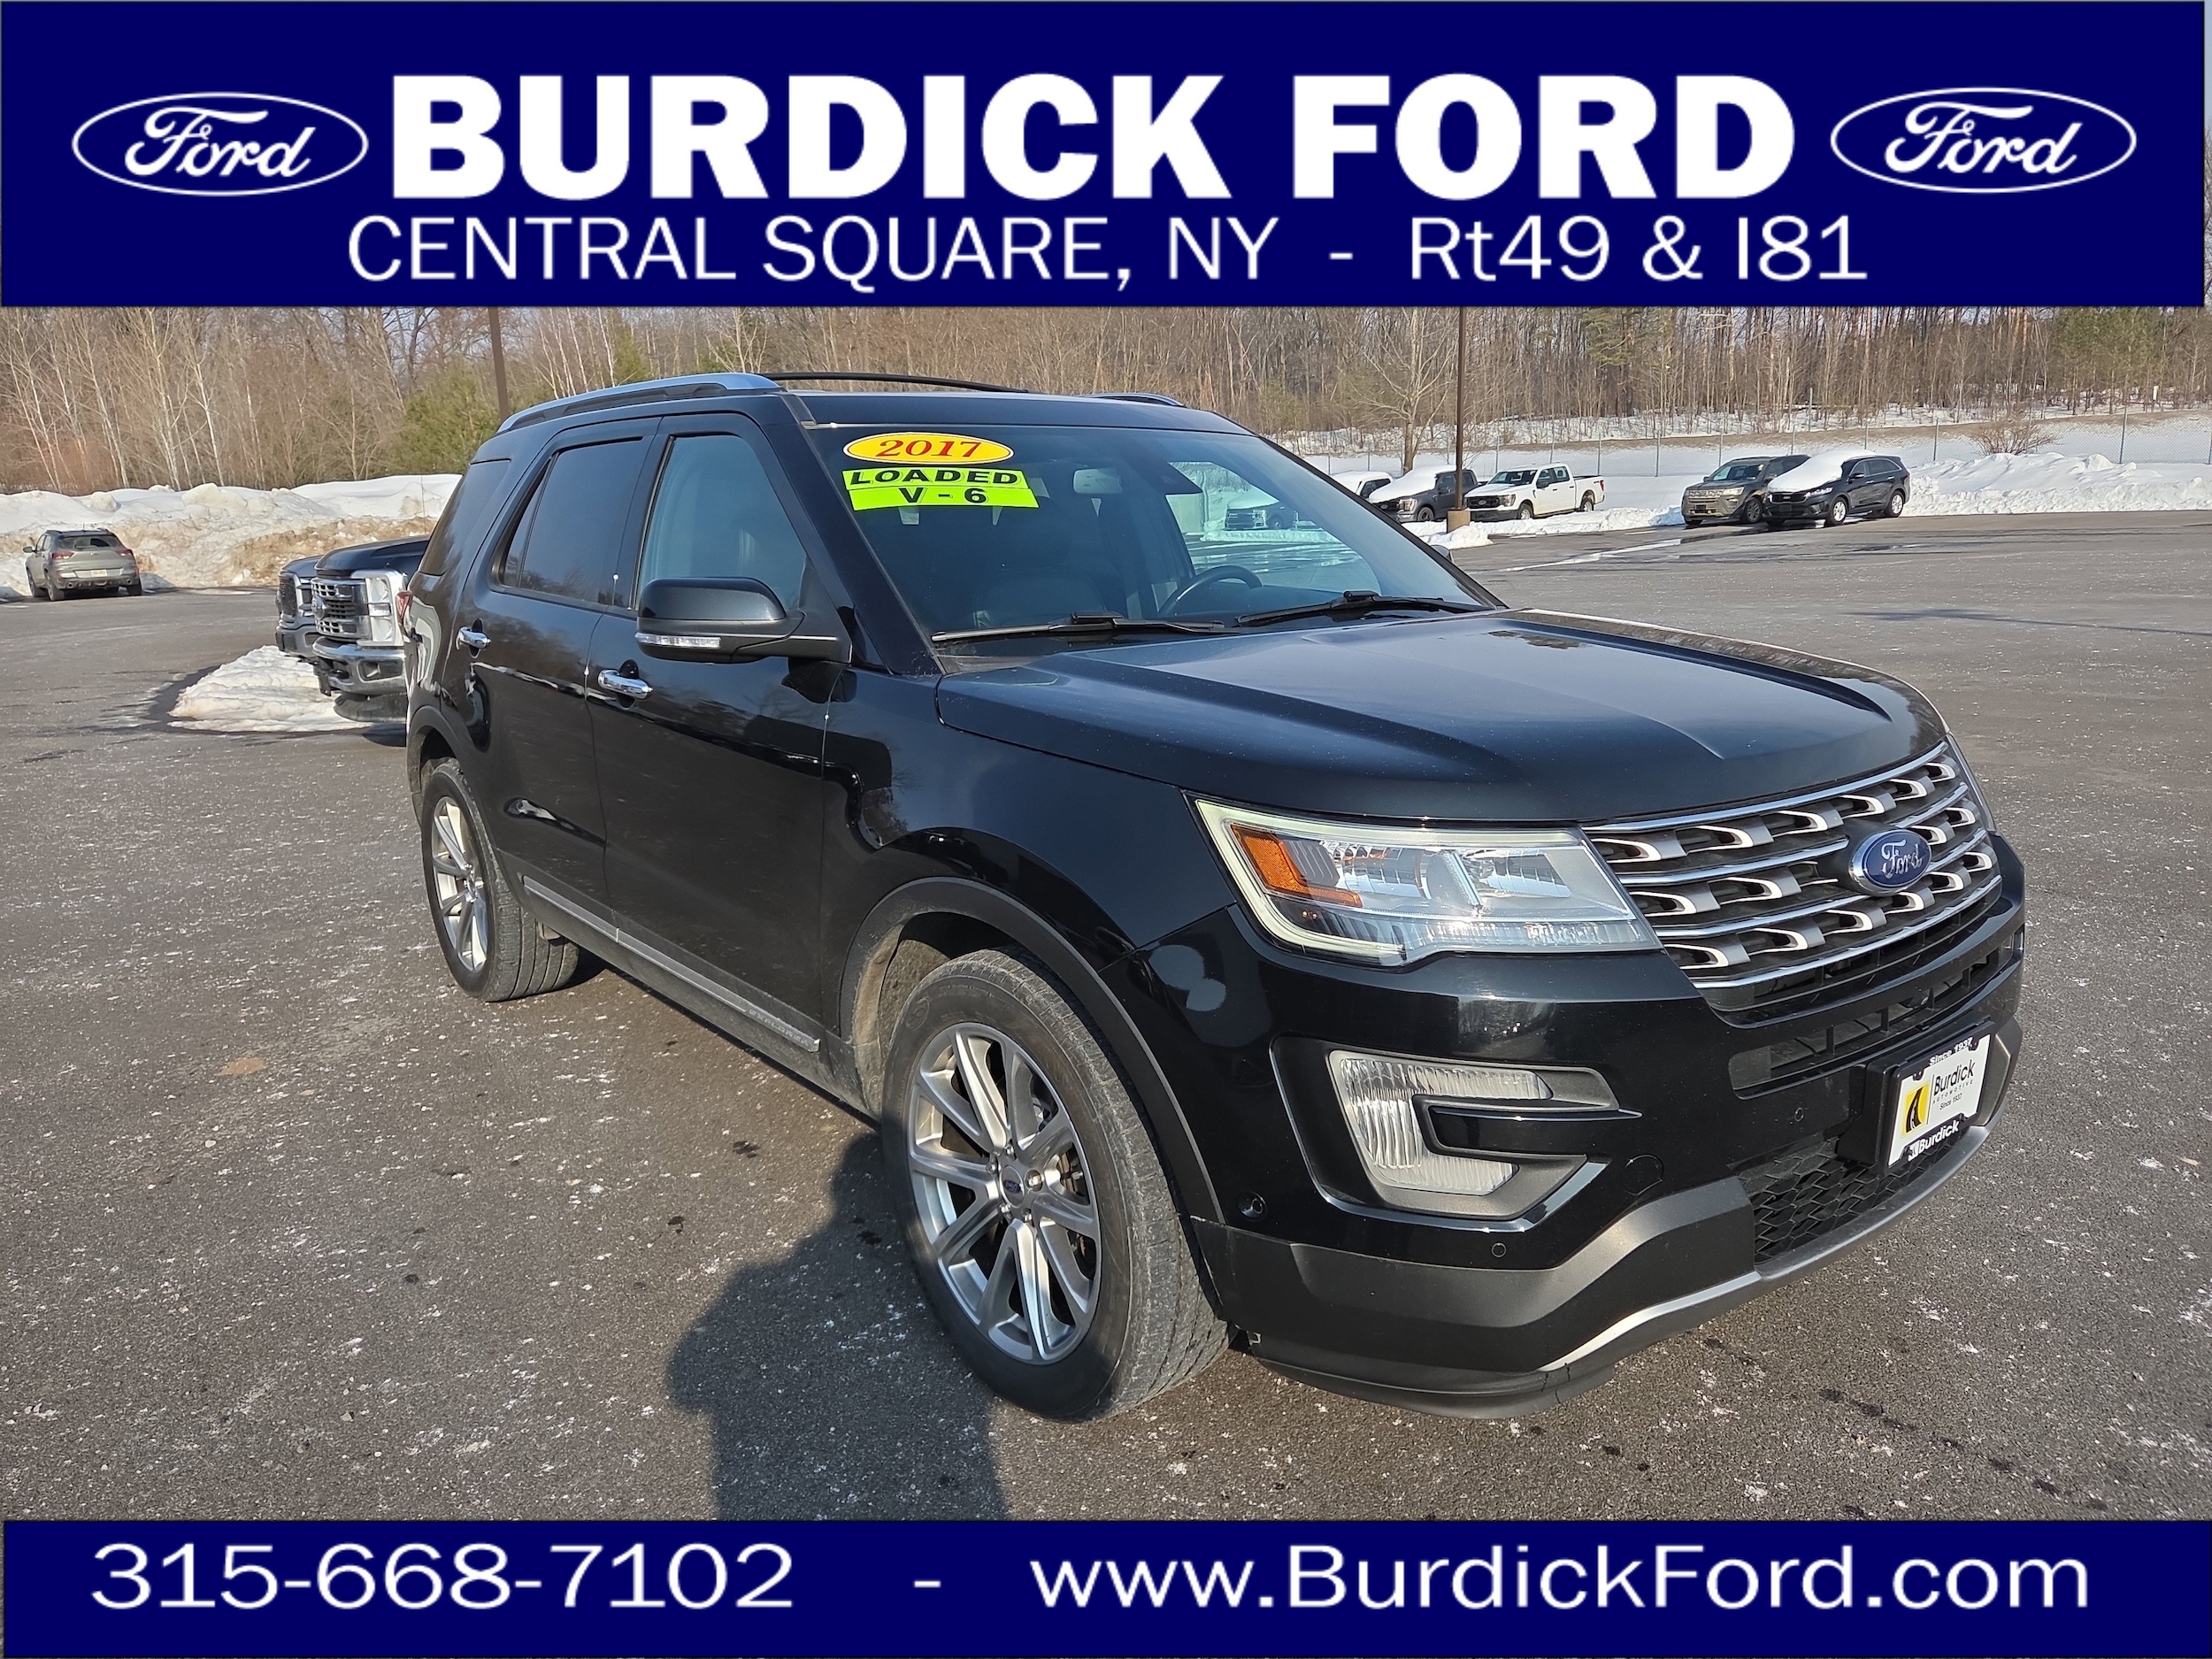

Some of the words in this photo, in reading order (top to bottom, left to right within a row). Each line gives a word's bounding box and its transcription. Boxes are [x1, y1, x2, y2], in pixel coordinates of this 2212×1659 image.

[875, 440, 981, 457] 2017
[850, 470, 1018, 485] LOADED
[1881, 839, 1923, 879] Ford
[1933, 1059, 1975, 1096] Burdick
[1918, 1119, 1960, 1154] Burdick
